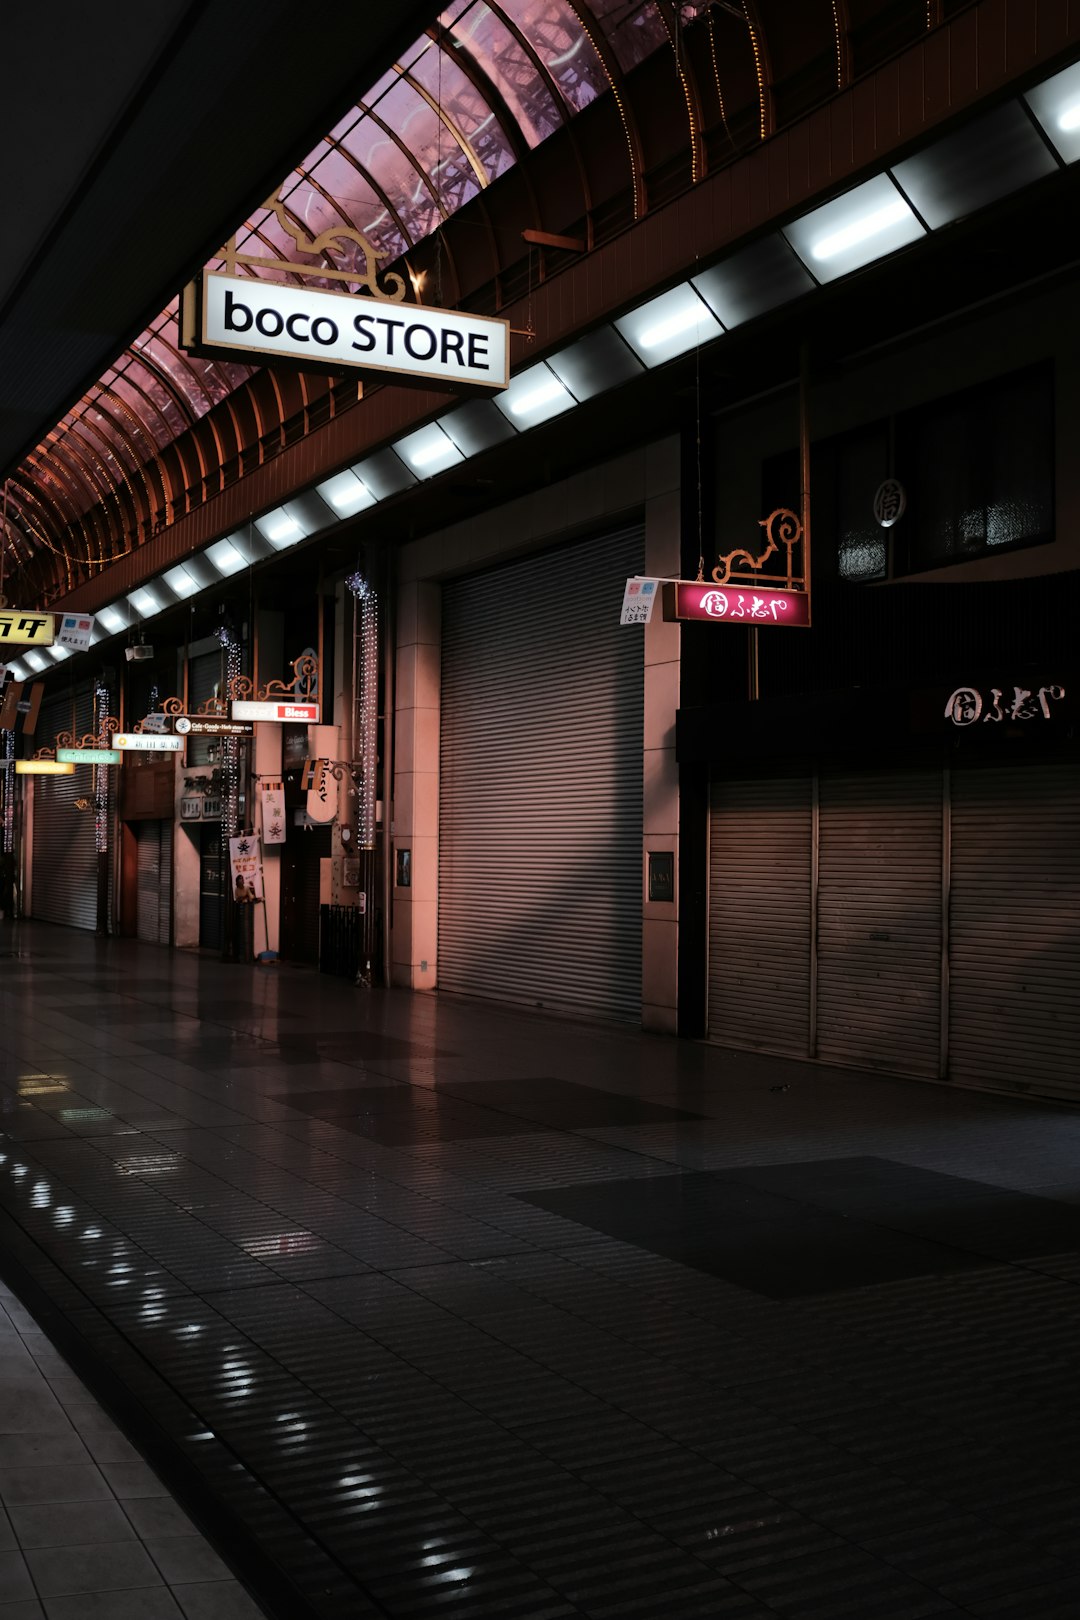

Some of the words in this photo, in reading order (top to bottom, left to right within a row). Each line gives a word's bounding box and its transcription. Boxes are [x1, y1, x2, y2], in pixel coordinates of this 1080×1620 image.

[224, 290, 339, 346] boco
[351, 314, 490, 370] STORE
[284, 707, 309, 718] Bless
